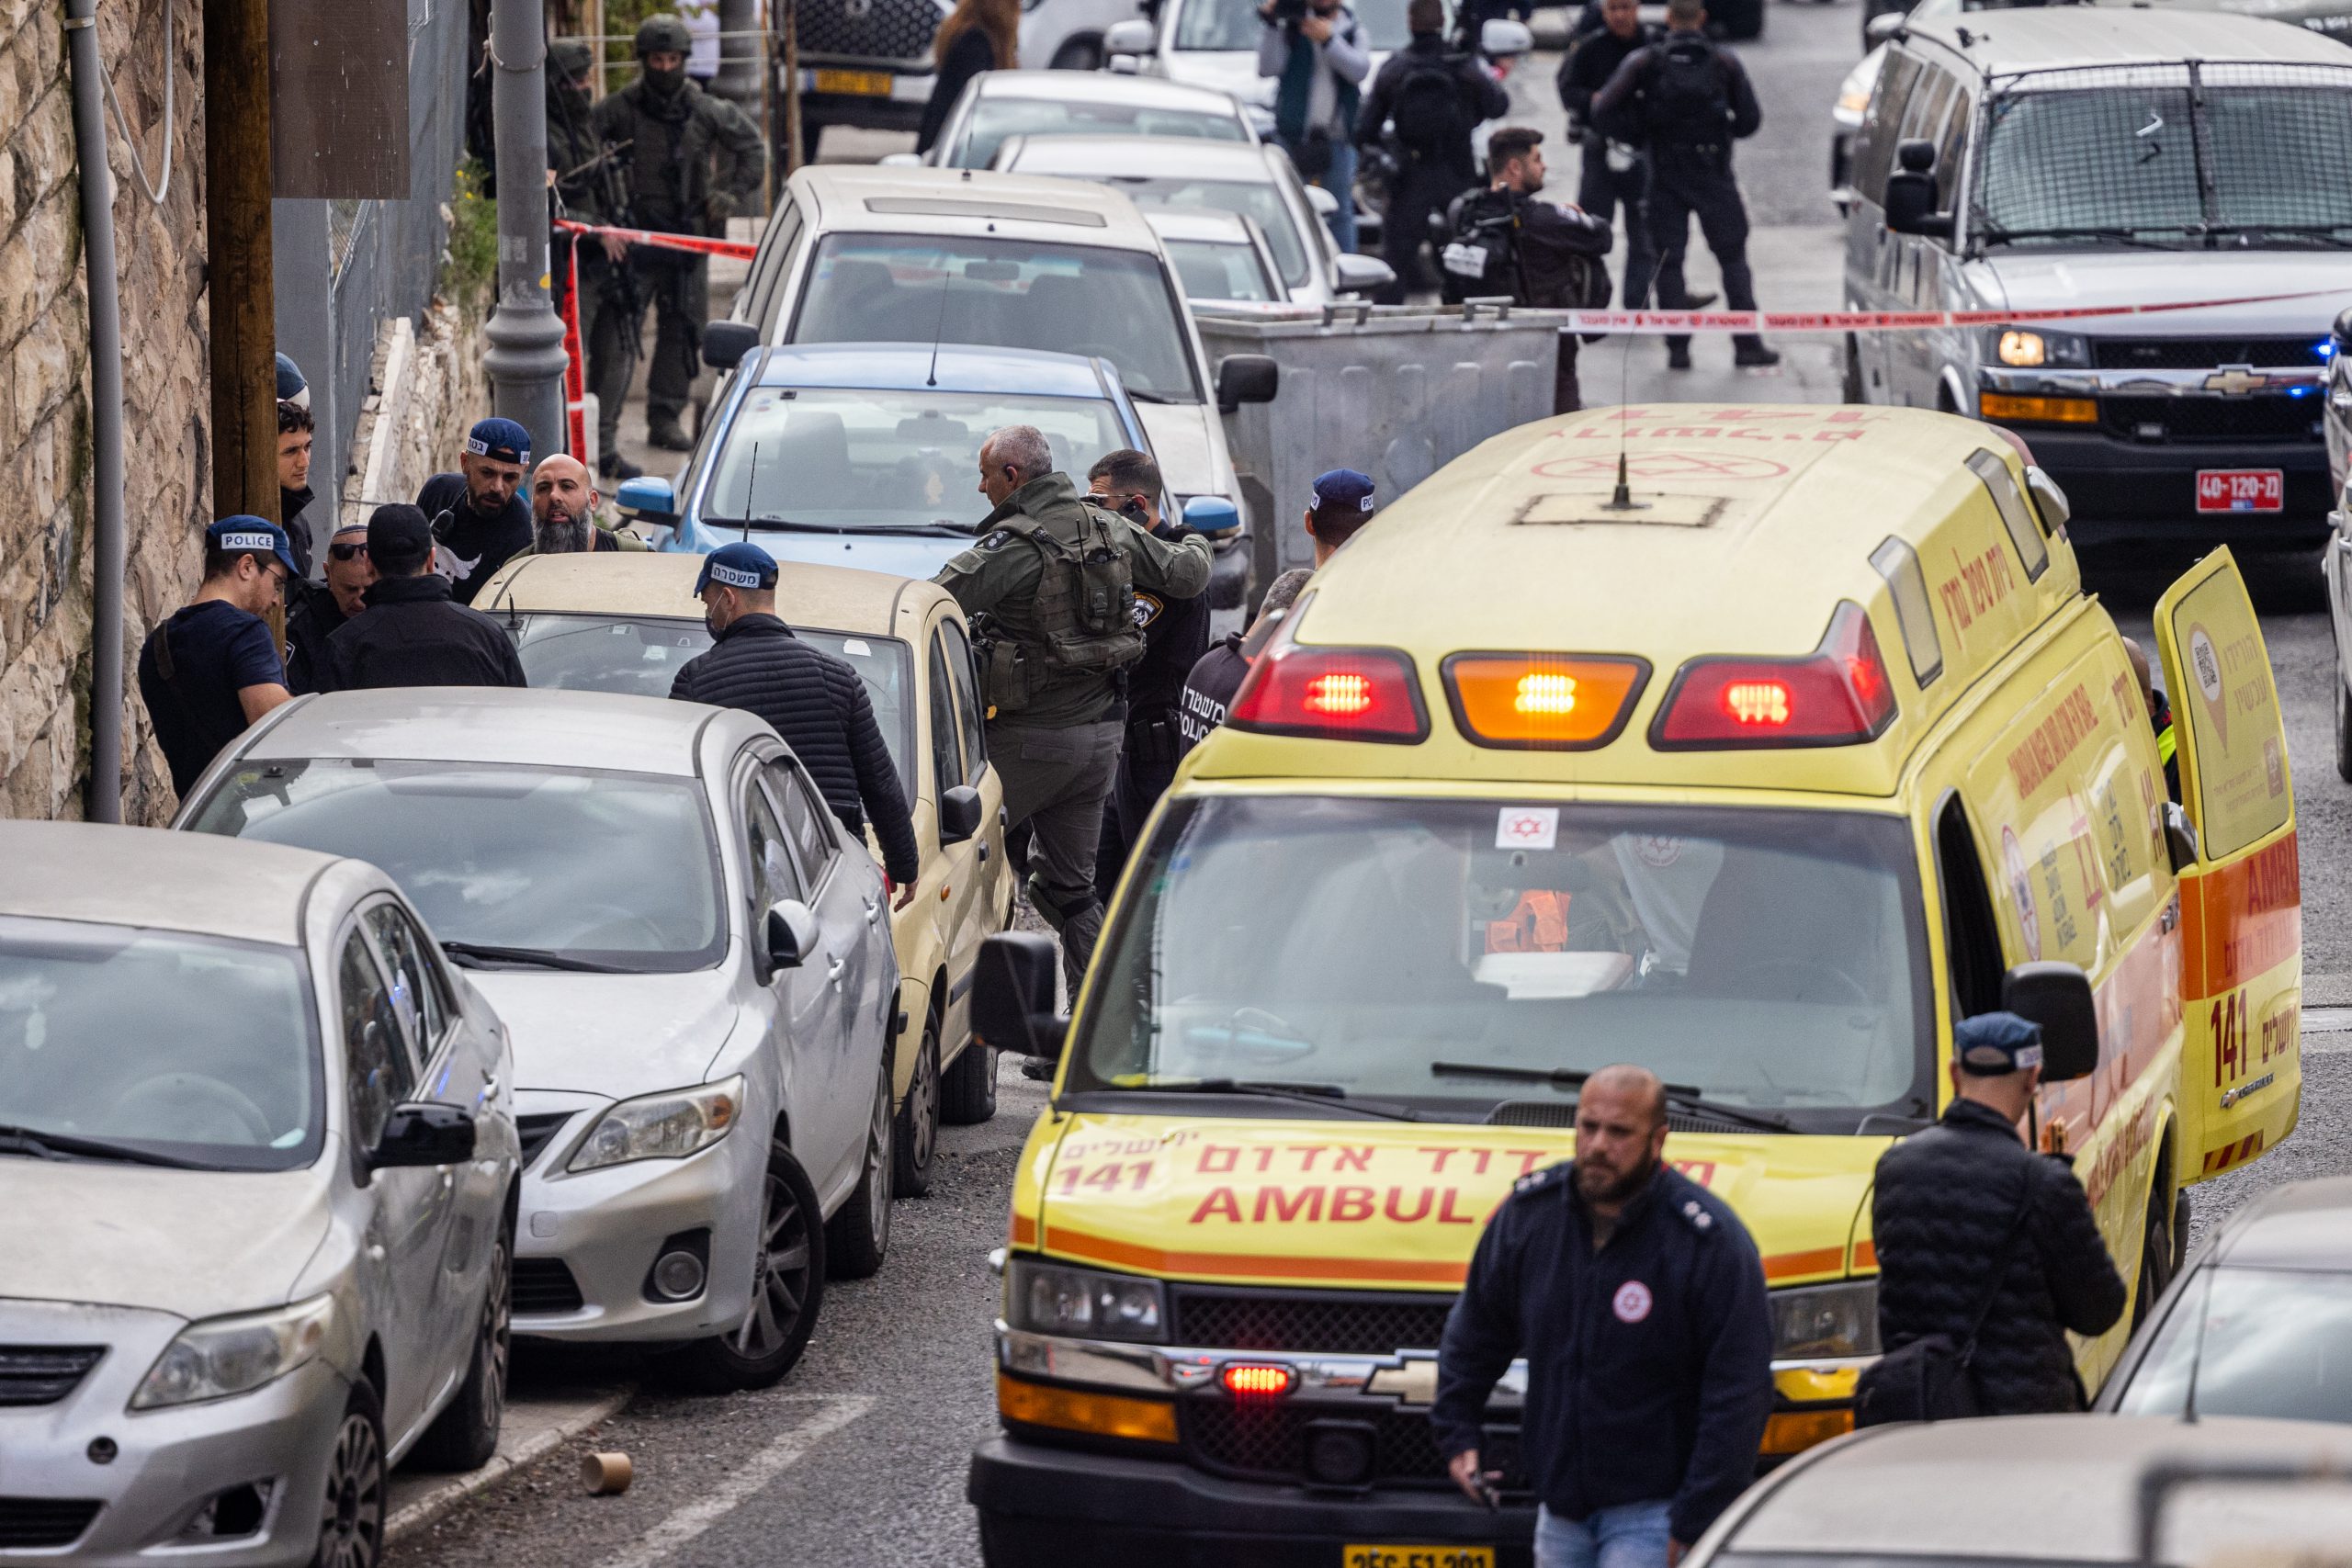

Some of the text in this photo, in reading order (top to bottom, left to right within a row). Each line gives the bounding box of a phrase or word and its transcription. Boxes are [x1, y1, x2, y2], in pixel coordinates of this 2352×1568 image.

[225, 536, 272, 547] POLICE
[713, 567, 757, 585] משטרה
[2211, 988, 2247, 1088] 141
[2262, 1004, 2297, 1064] ירושלים
[1057, 1160, 1155, 1196] 141
[1195, 1145, 1547, 1177] דוד אדום
[1187, 1185, 1511, 1224] AMBUL
